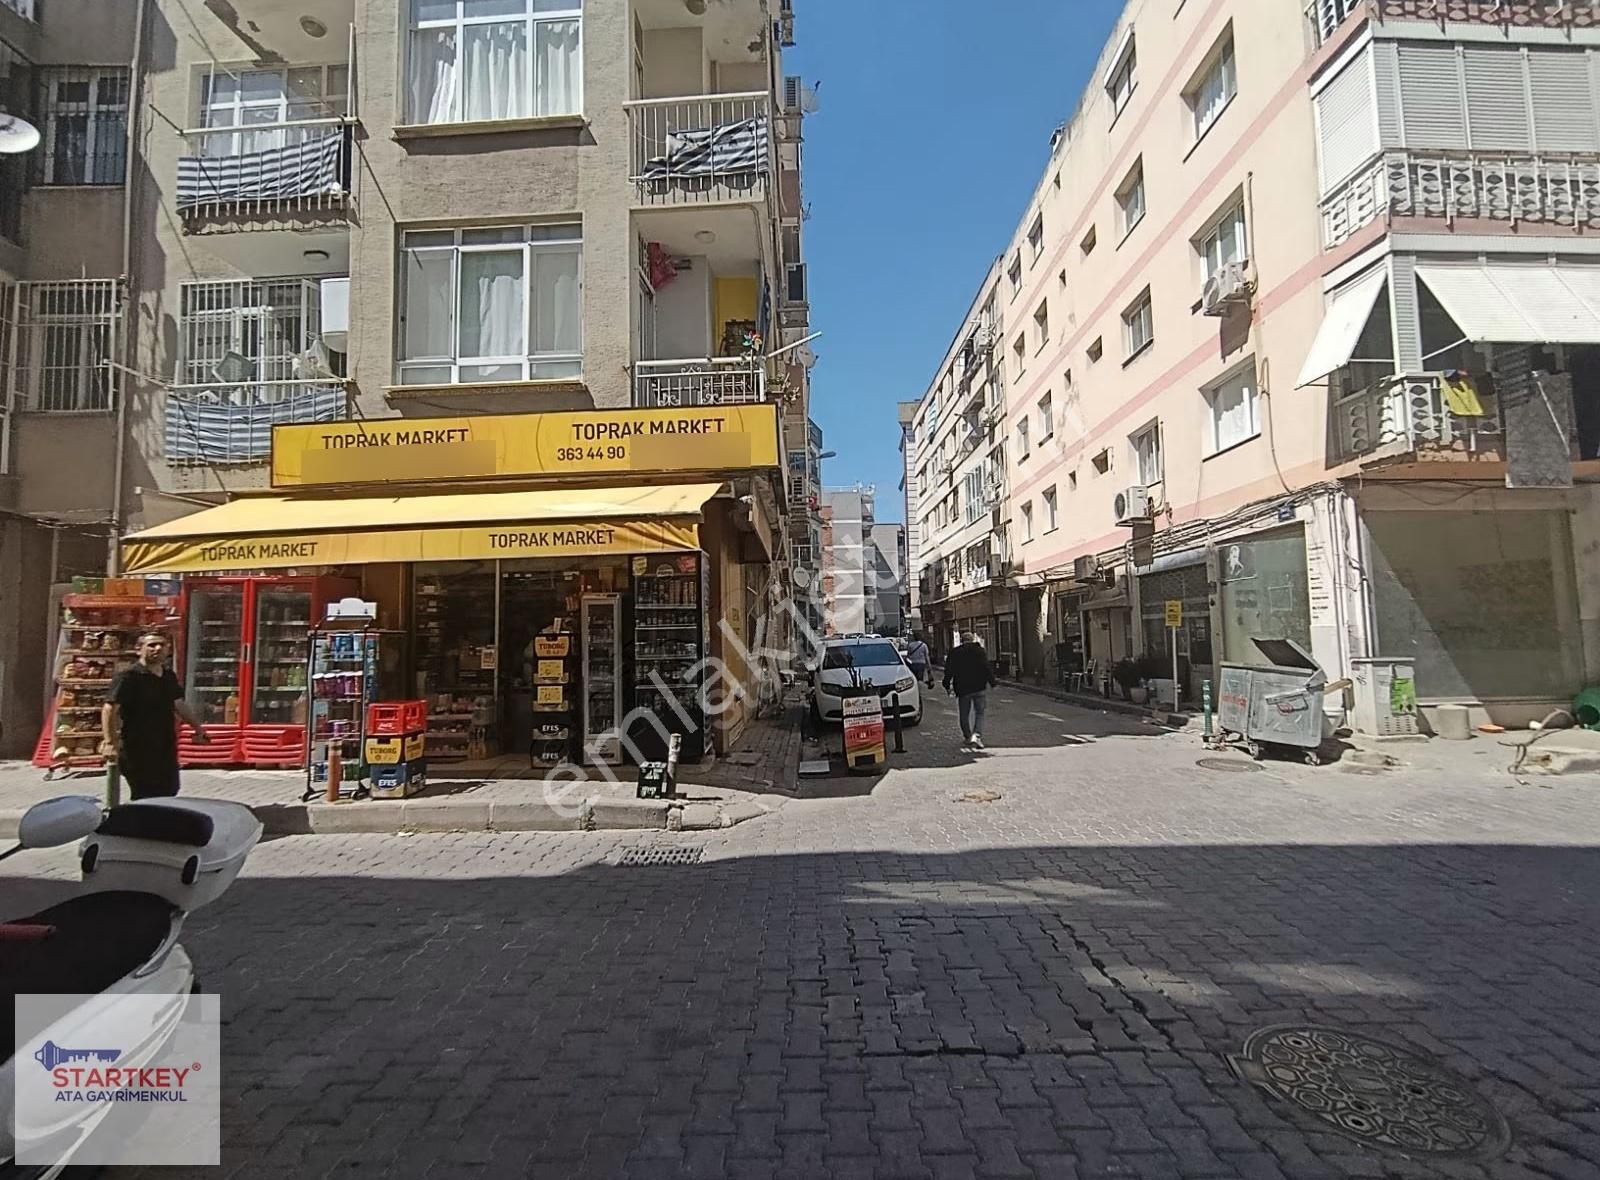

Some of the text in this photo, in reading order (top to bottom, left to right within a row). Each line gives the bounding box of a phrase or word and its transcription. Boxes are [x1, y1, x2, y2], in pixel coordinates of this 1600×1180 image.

[321, 428, 469, 449] TOPRAK MARKET
[572, 418, 725, 440] TOPRAK MARKET
[557, 445, 625, 461] 363 44 90
[488, 529, 615, 549] TOPRAK MARKET
[200, 542, 318, 561] TOPRAK MARKET
[369, 747, 398, 755] TUBORG
